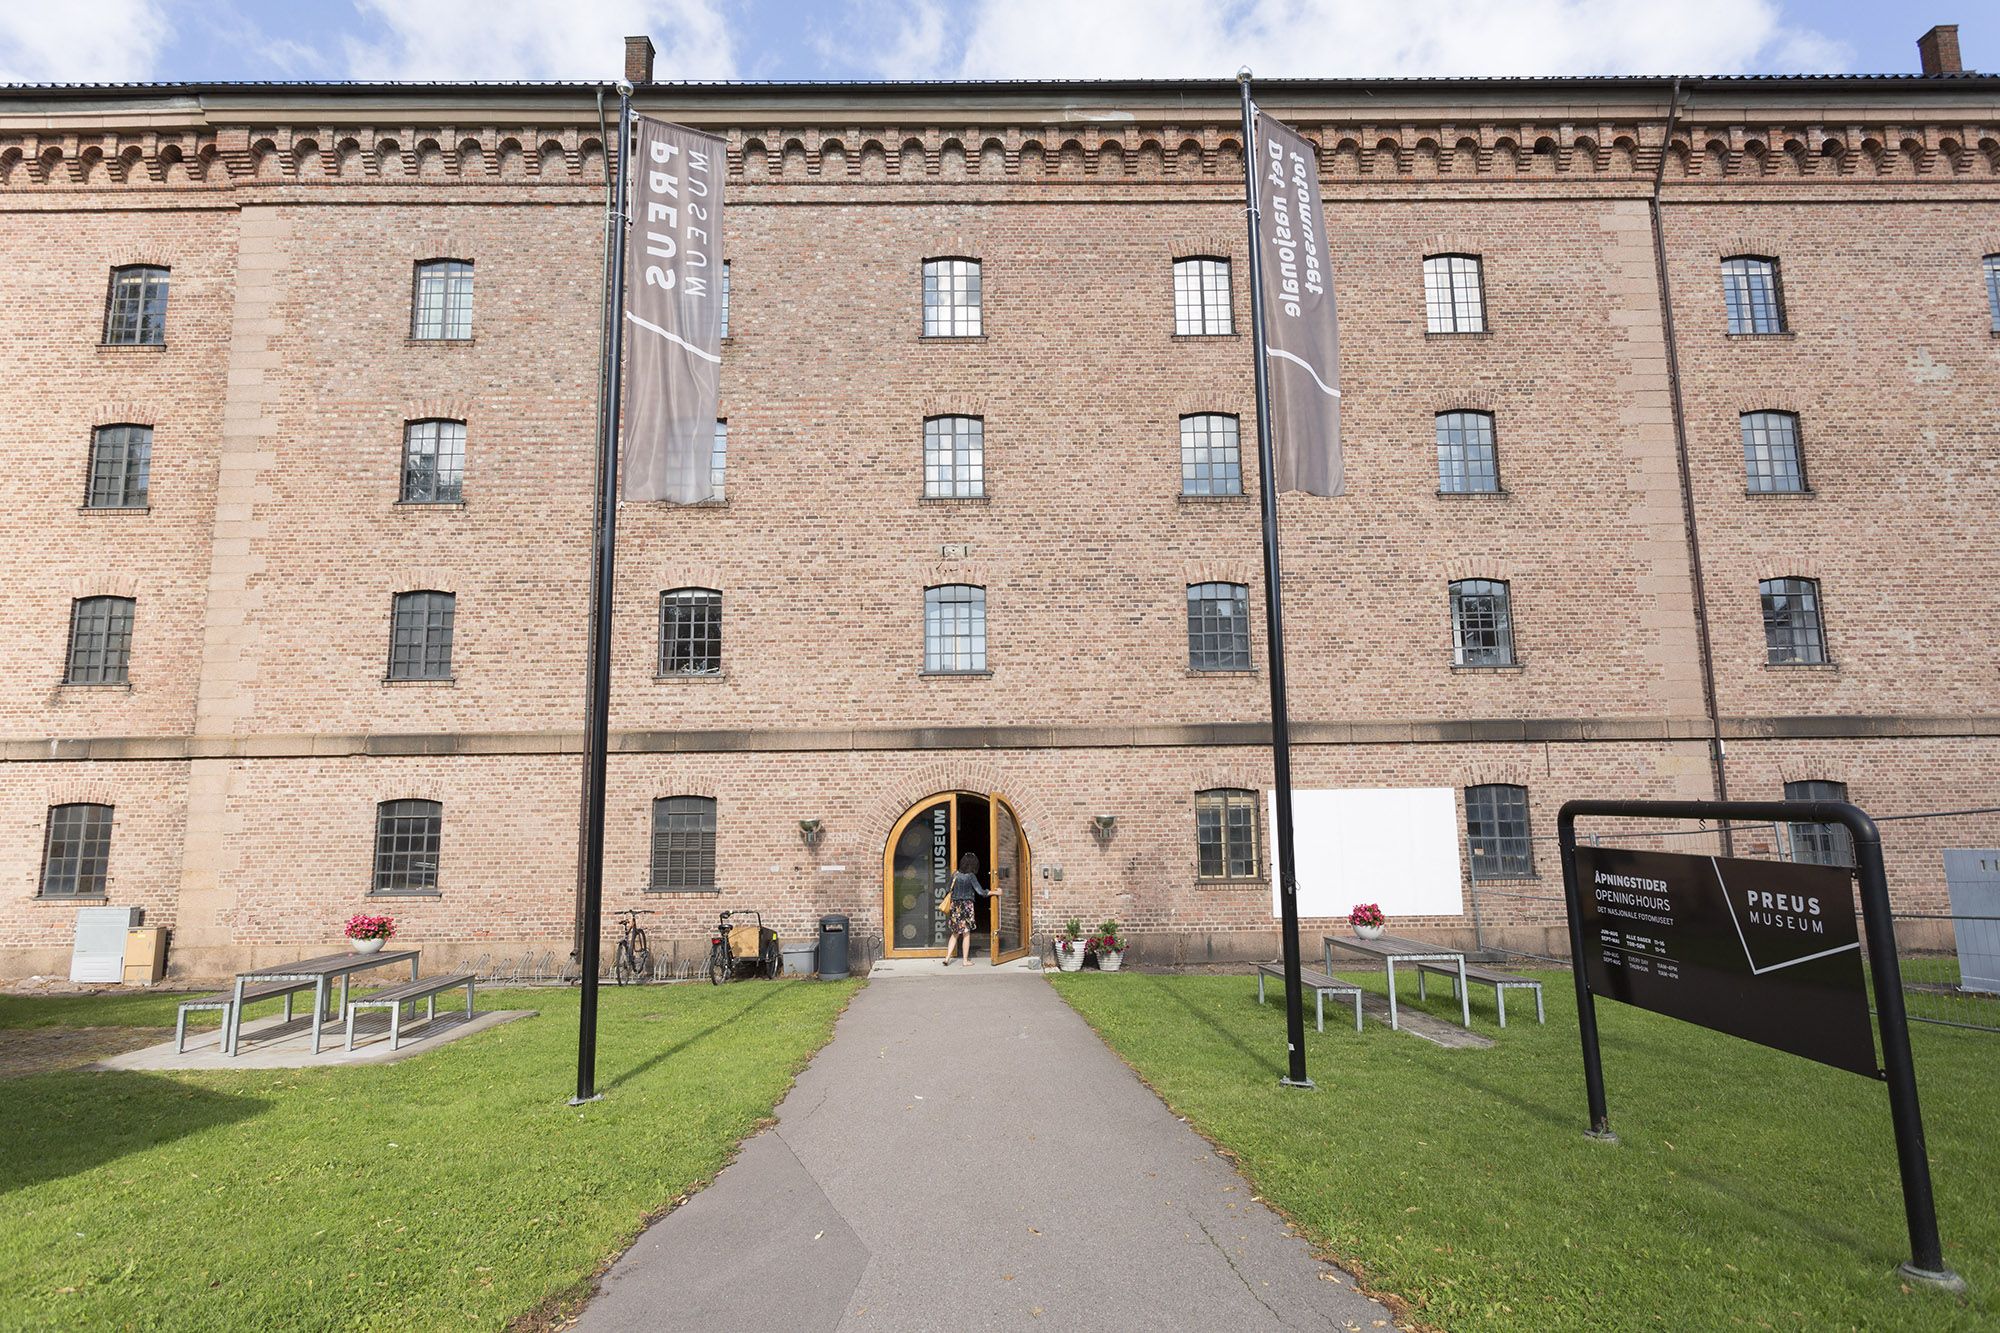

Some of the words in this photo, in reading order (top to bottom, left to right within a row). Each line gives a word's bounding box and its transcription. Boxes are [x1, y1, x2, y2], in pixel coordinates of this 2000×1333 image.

[934, 809, 946, 883] MUSEUM
[1594, 870, 1668, 893] ÅPNINGSTIDER
[1748, 890, 1820, 915] PREUS
[1608, 907, 1638, 919] NASJONALE
[1638, 912, 1674, 925] FOTOMUSEET
[1749, 910, 1824, 934] MUSEUM
